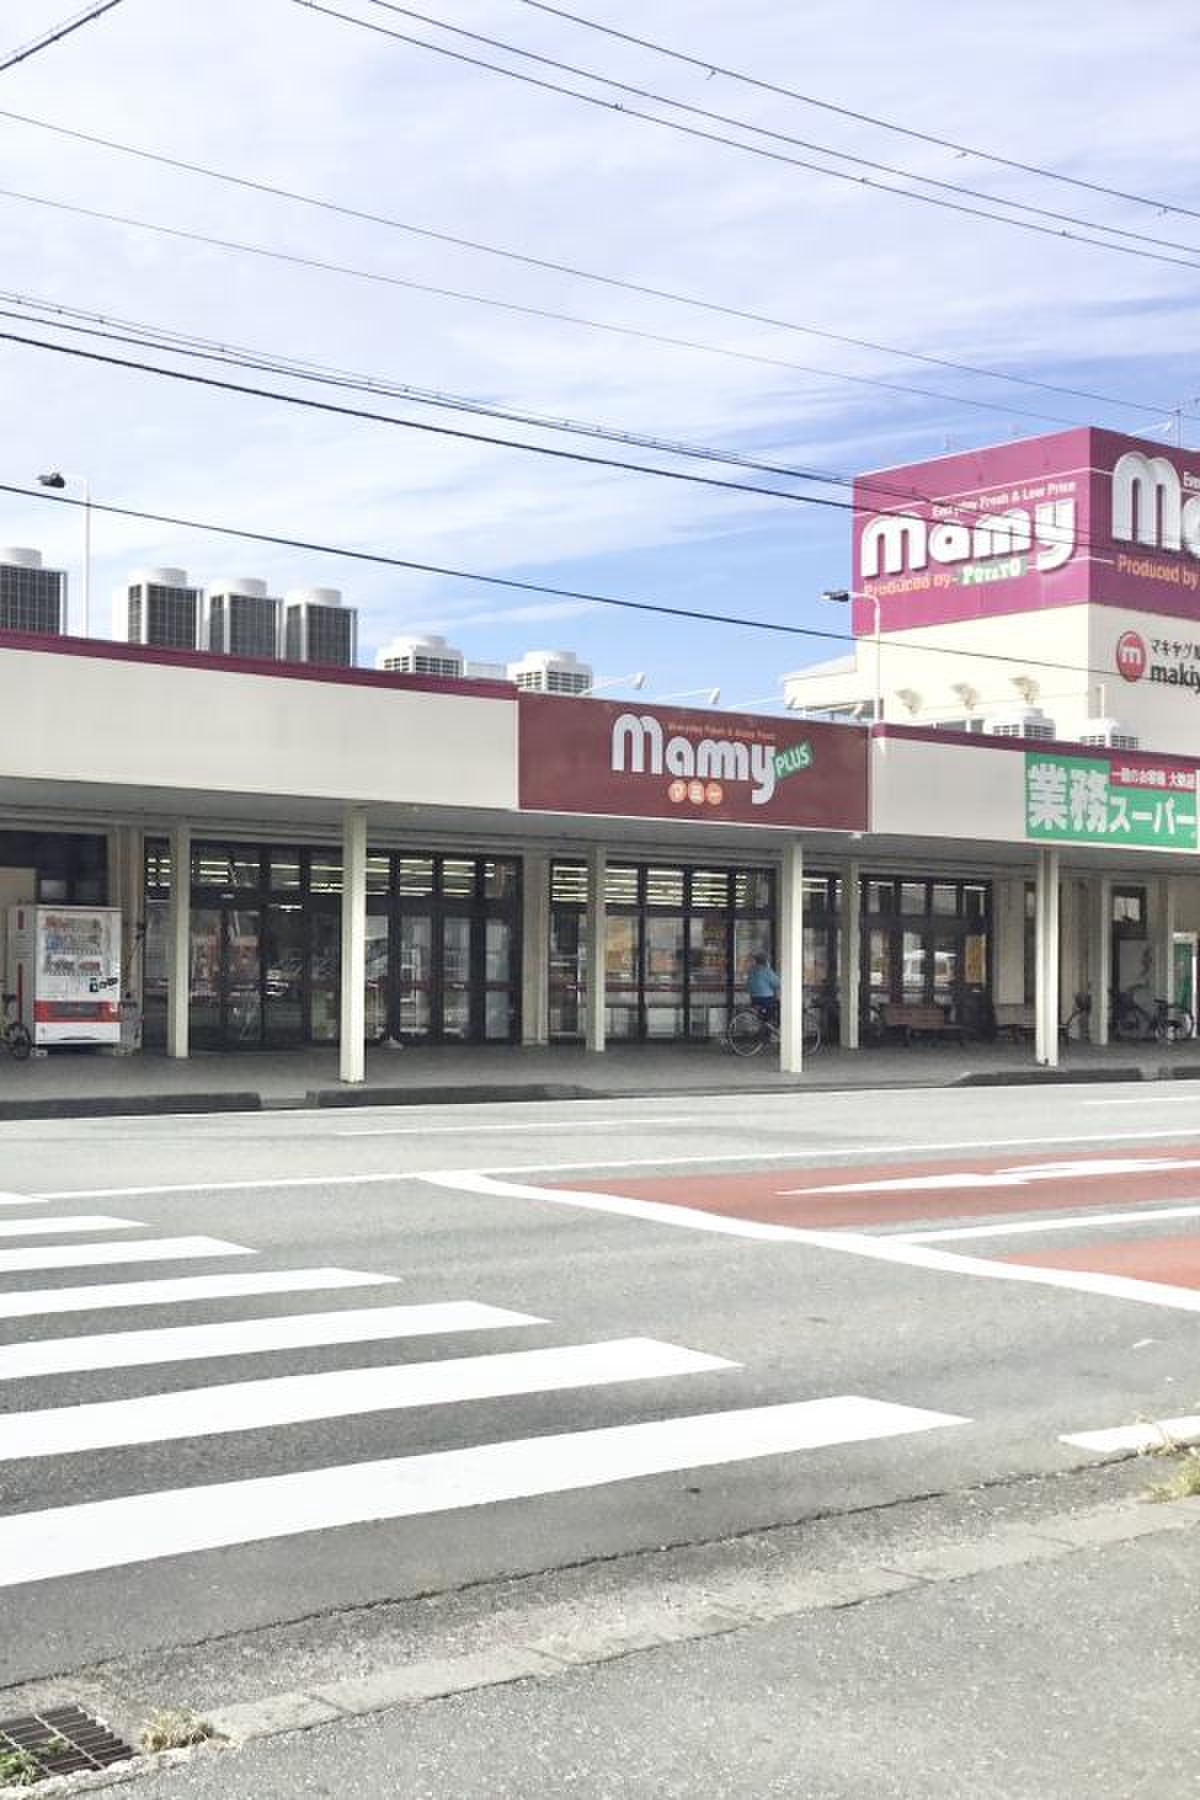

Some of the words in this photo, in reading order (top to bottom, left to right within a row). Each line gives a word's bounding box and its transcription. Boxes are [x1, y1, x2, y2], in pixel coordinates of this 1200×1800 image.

[1118, 554, 1179, 583] Produced
[864, 576, 929, 596] Produced
[775, 743, 810, 777] PLUS
[1028, 763, 1195, 835] 業務スーパー
